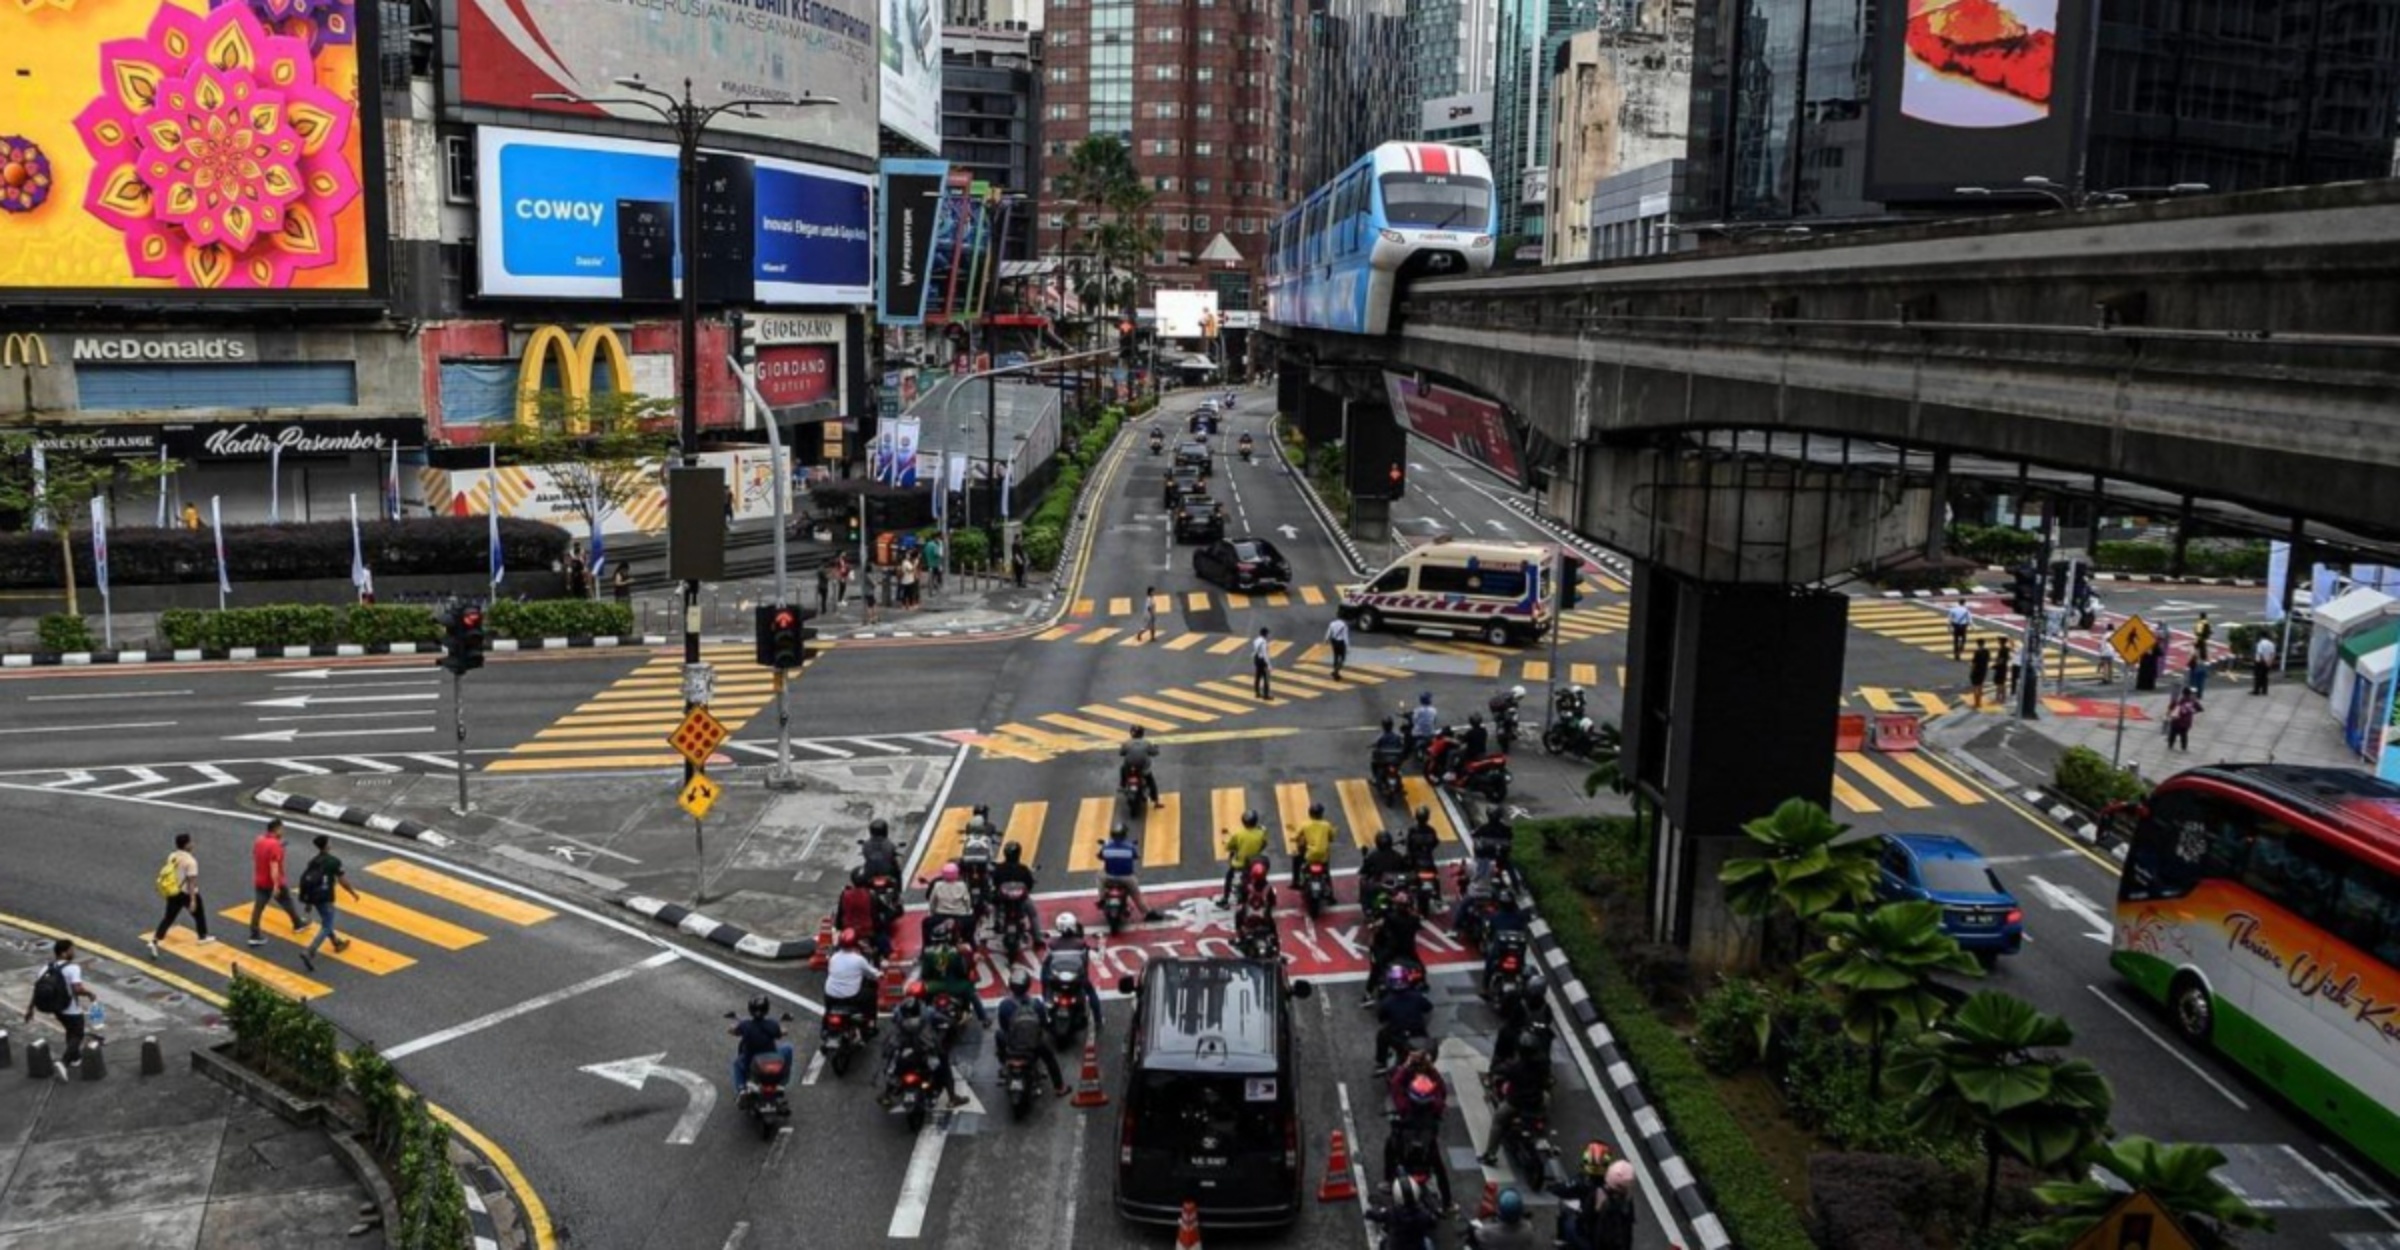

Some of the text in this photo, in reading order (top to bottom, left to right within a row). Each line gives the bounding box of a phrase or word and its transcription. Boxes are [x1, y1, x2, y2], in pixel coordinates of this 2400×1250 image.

[515, 199, 603, 227] coway
[761, 318, 833, 340] GIORDANO
[73, 338, 245, 359] McDonald's
[757, 359, 826, 381] GIORDANO
[205, 424, 386, 456] Kadir Pasembor
[2223, 911, 2283, 969] Thrive
